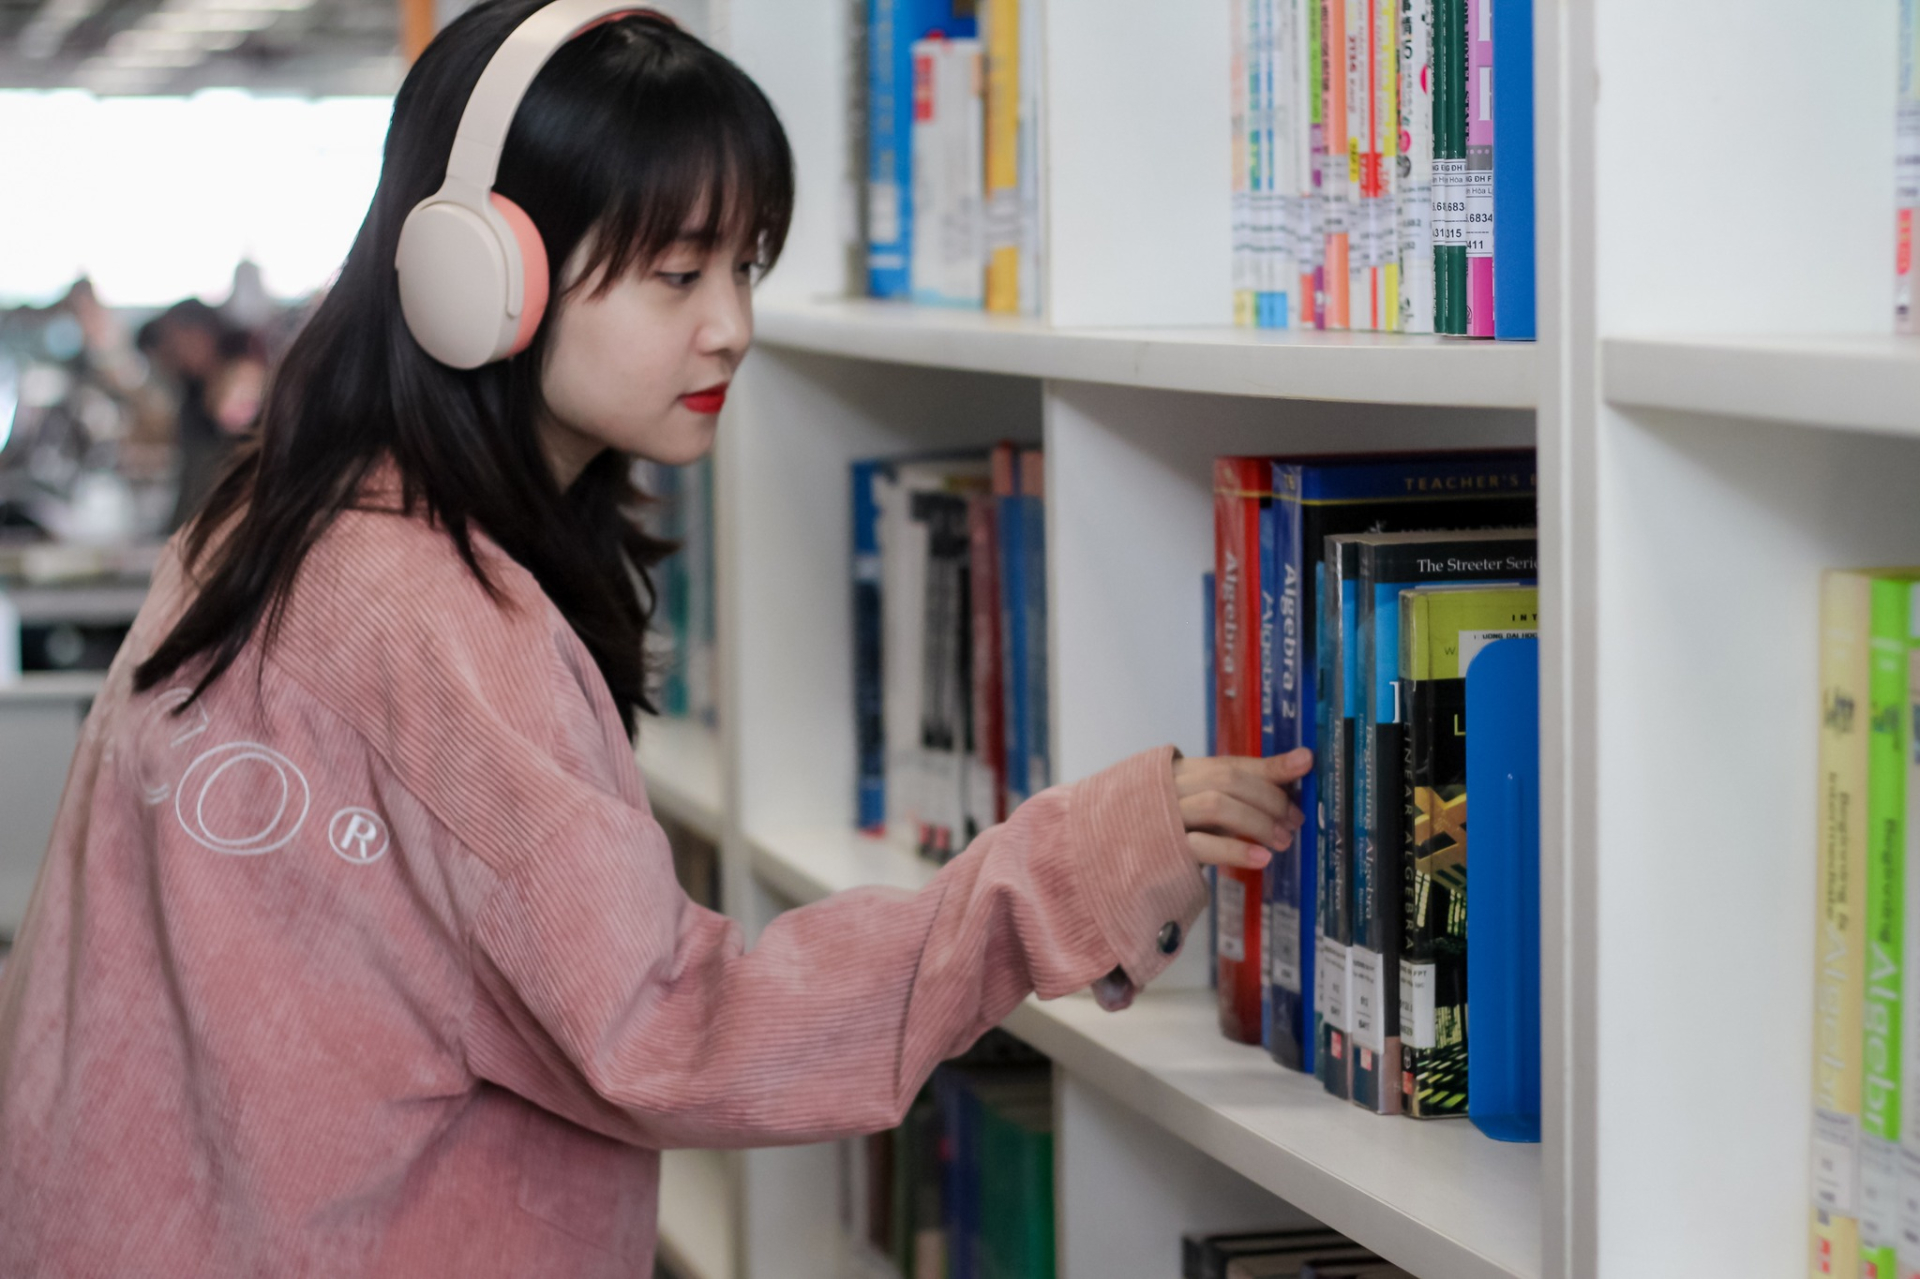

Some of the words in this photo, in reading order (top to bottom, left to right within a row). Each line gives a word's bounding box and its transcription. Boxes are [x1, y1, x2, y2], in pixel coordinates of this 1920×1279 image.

[1466, 213, 1493, 223] .6834
[1404, 474, 1519, 491] TEACHER'S
[1416, 558, 1444, 573] The
[1447, 556, 1502, 572] Streeter
[1223, 550, 1239, 675] Algebra
[1280, 563, 1298, 692] Algebra
[1282, 700, 1296, 719] 2
[1363, 725, 1375, 830] Beginning
[1403, 721, 1414, 816] LINEAR
[1333, 829, 1345, 911] Algebra
[1364, 837, 1375, 920] Algebra
[1404, 831, 1415, 951] ALGEBRA
